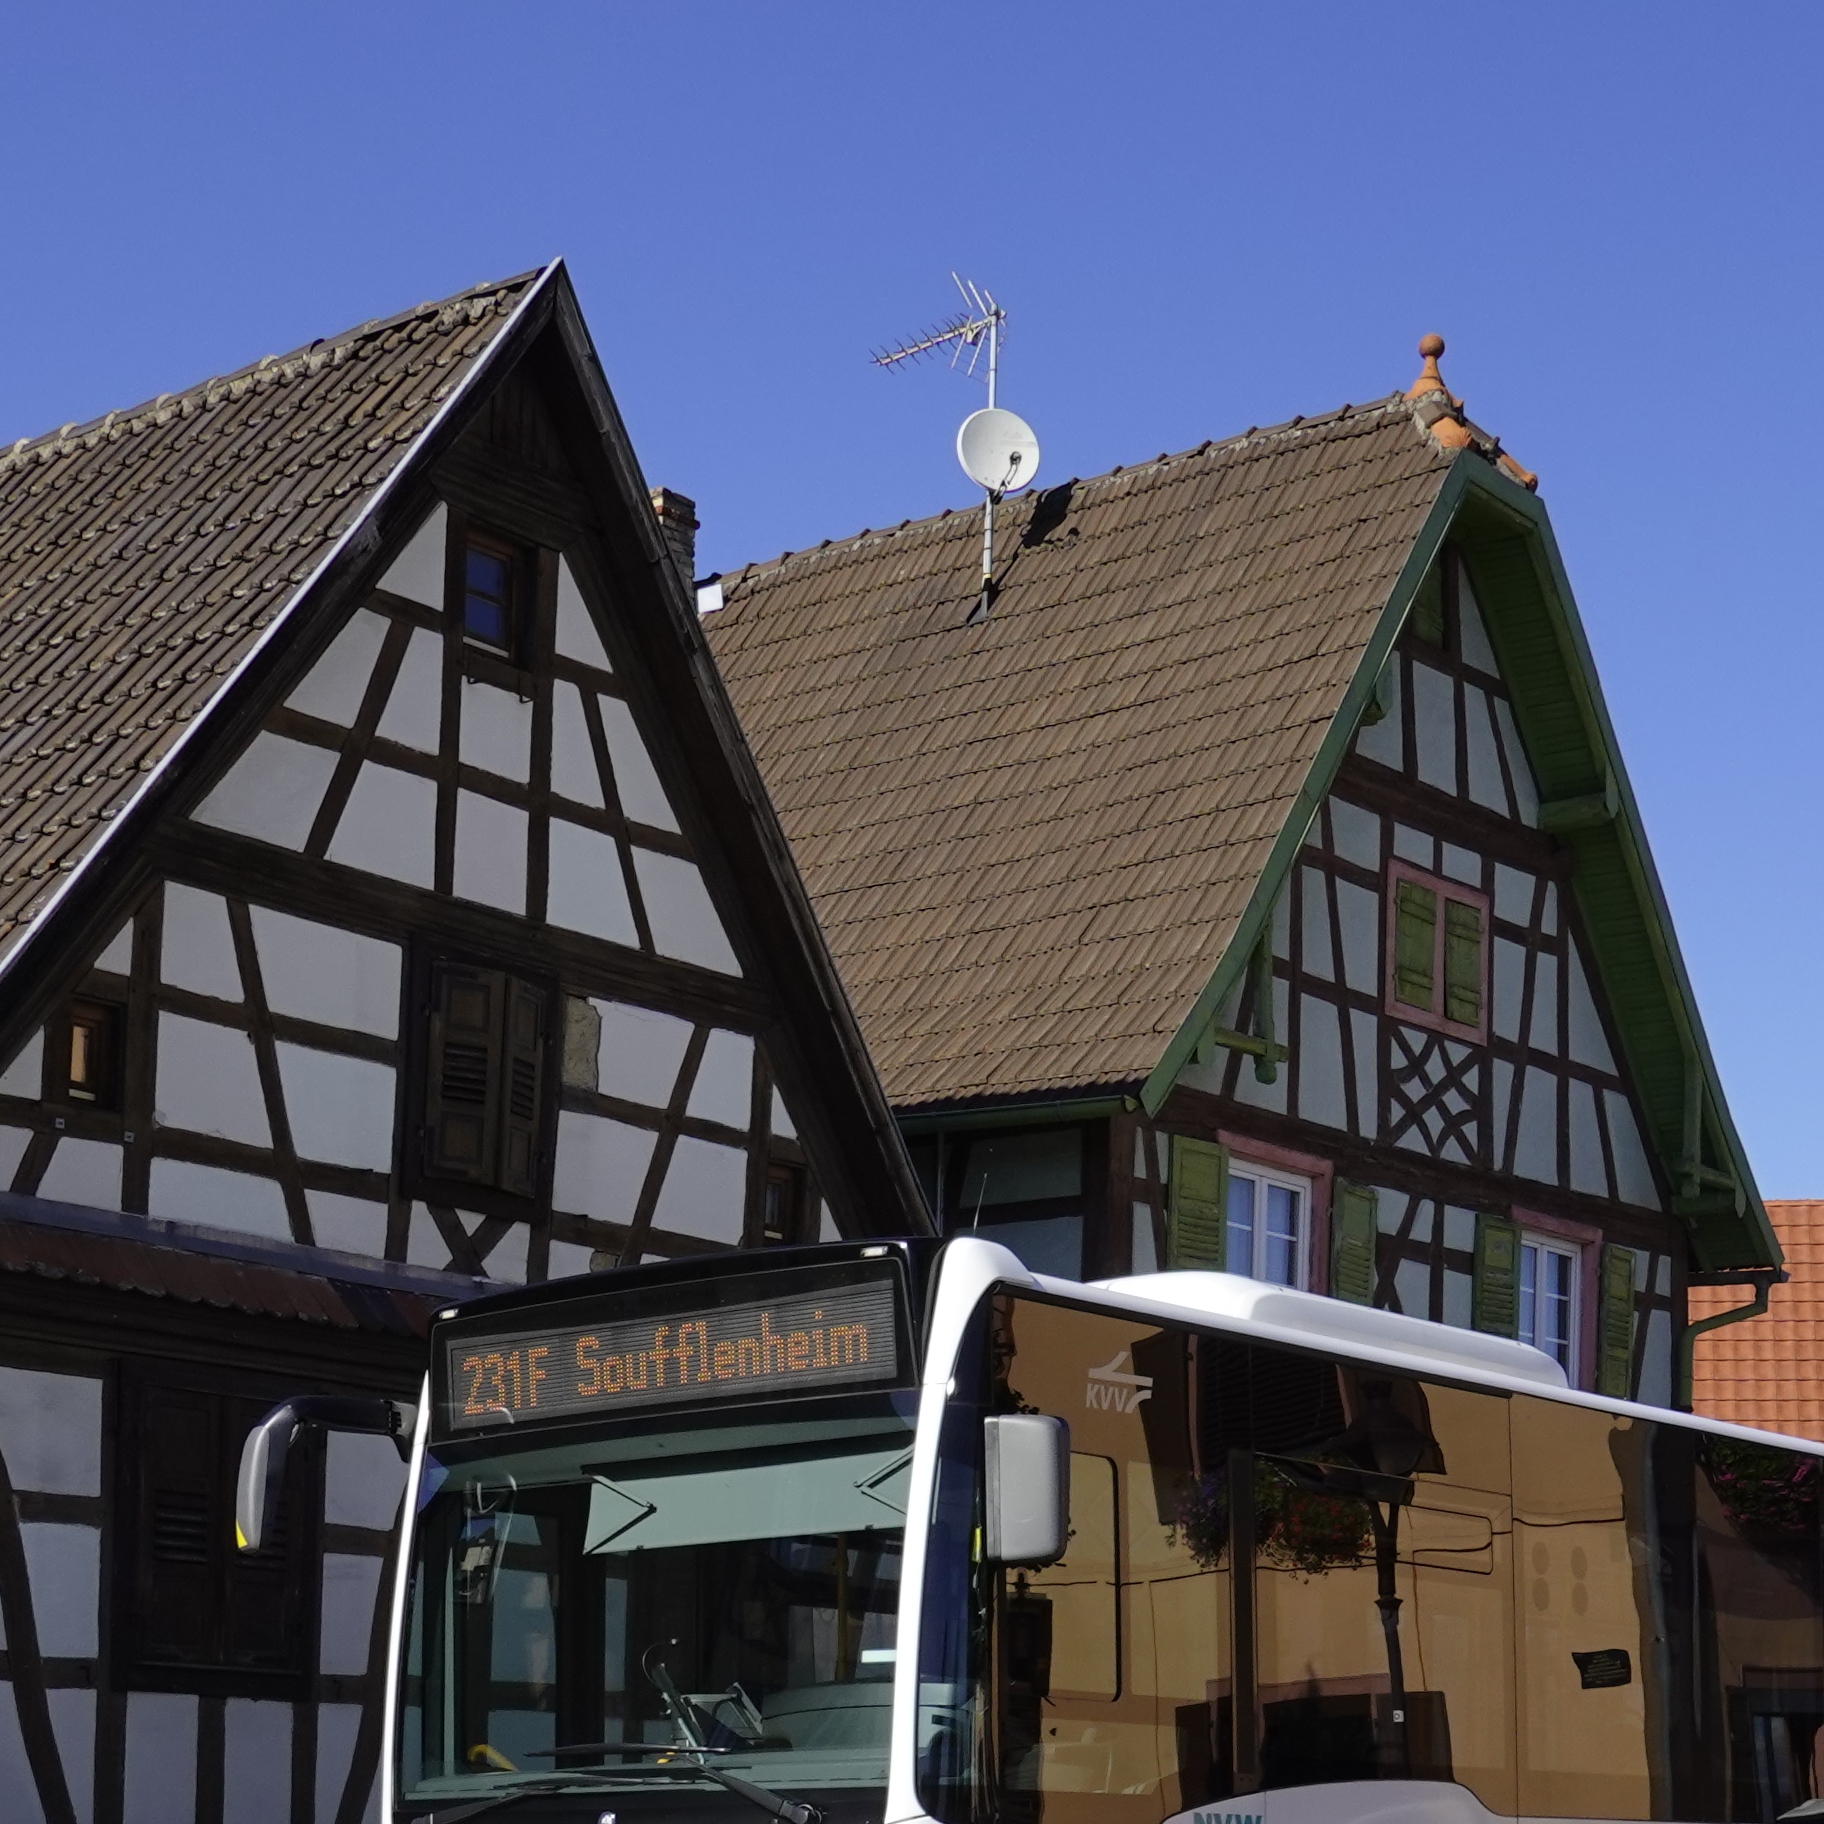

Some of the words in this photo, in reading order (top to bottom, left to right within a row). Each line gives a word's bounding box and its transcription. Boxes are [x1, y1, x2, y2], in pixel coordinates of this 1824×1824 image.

[462, 1347, 548, 1415] 231F
[575, 1310, 868, 1396] Soufflenheim
[1085, 1383, 1127, 1412] KVV
